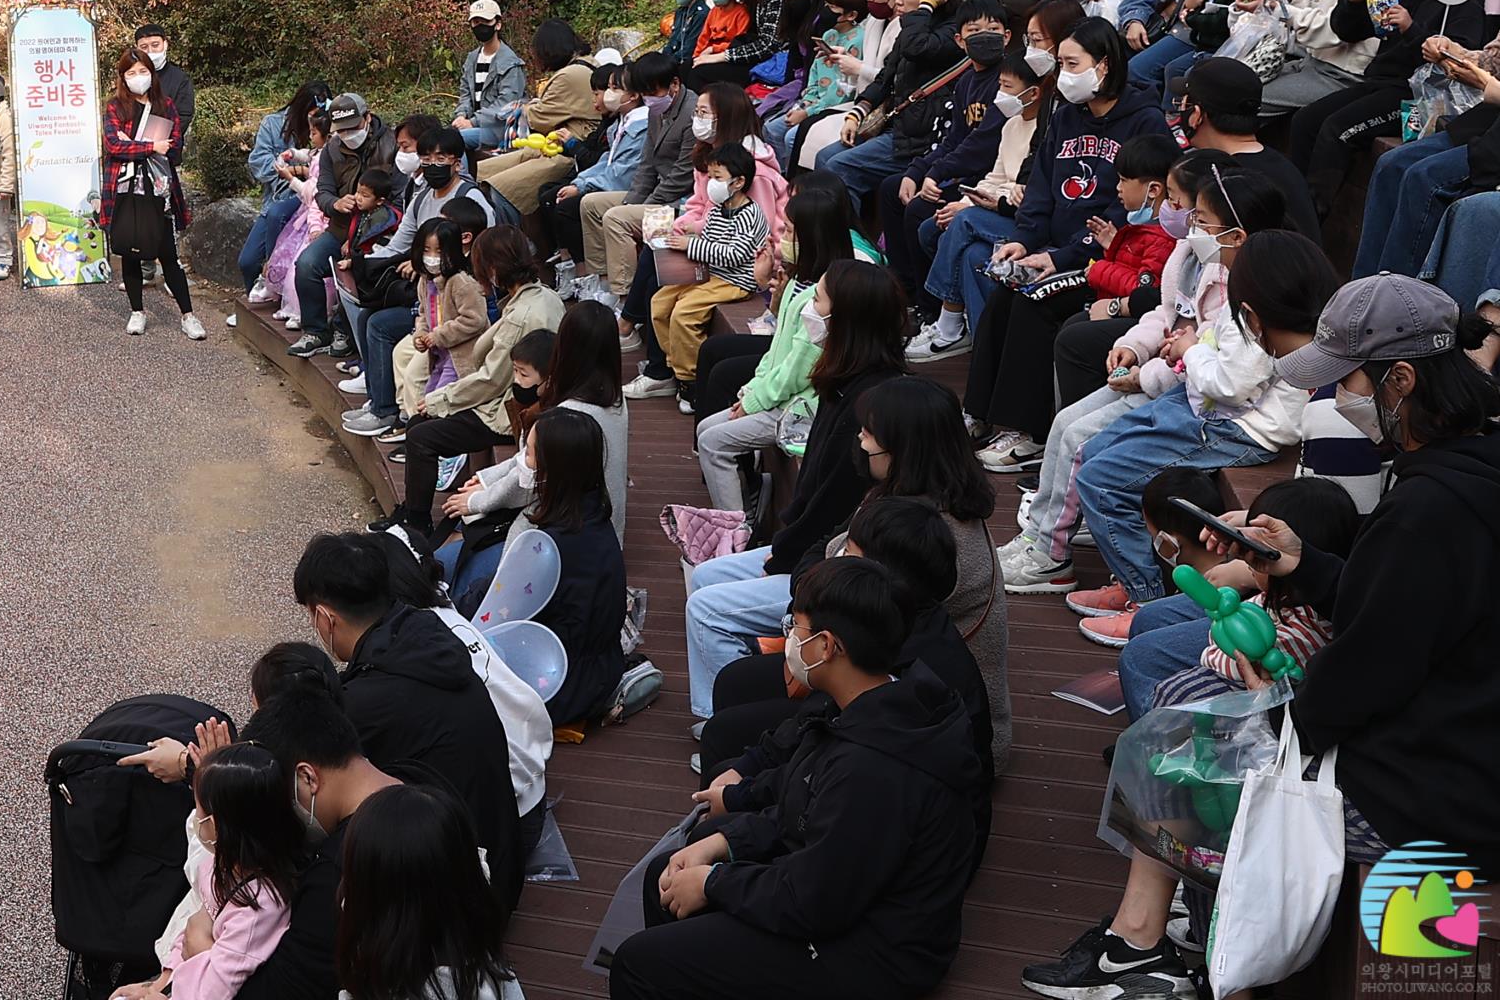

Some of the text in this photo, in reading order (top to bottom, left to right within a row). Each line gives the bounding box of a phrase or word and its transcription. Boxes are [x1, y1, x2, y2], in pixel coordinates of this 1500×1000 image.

[34, 59, 75, 83] 행사
[25, 83, 87, 108] 준비중
[75, 154, 94, 165] Tales
